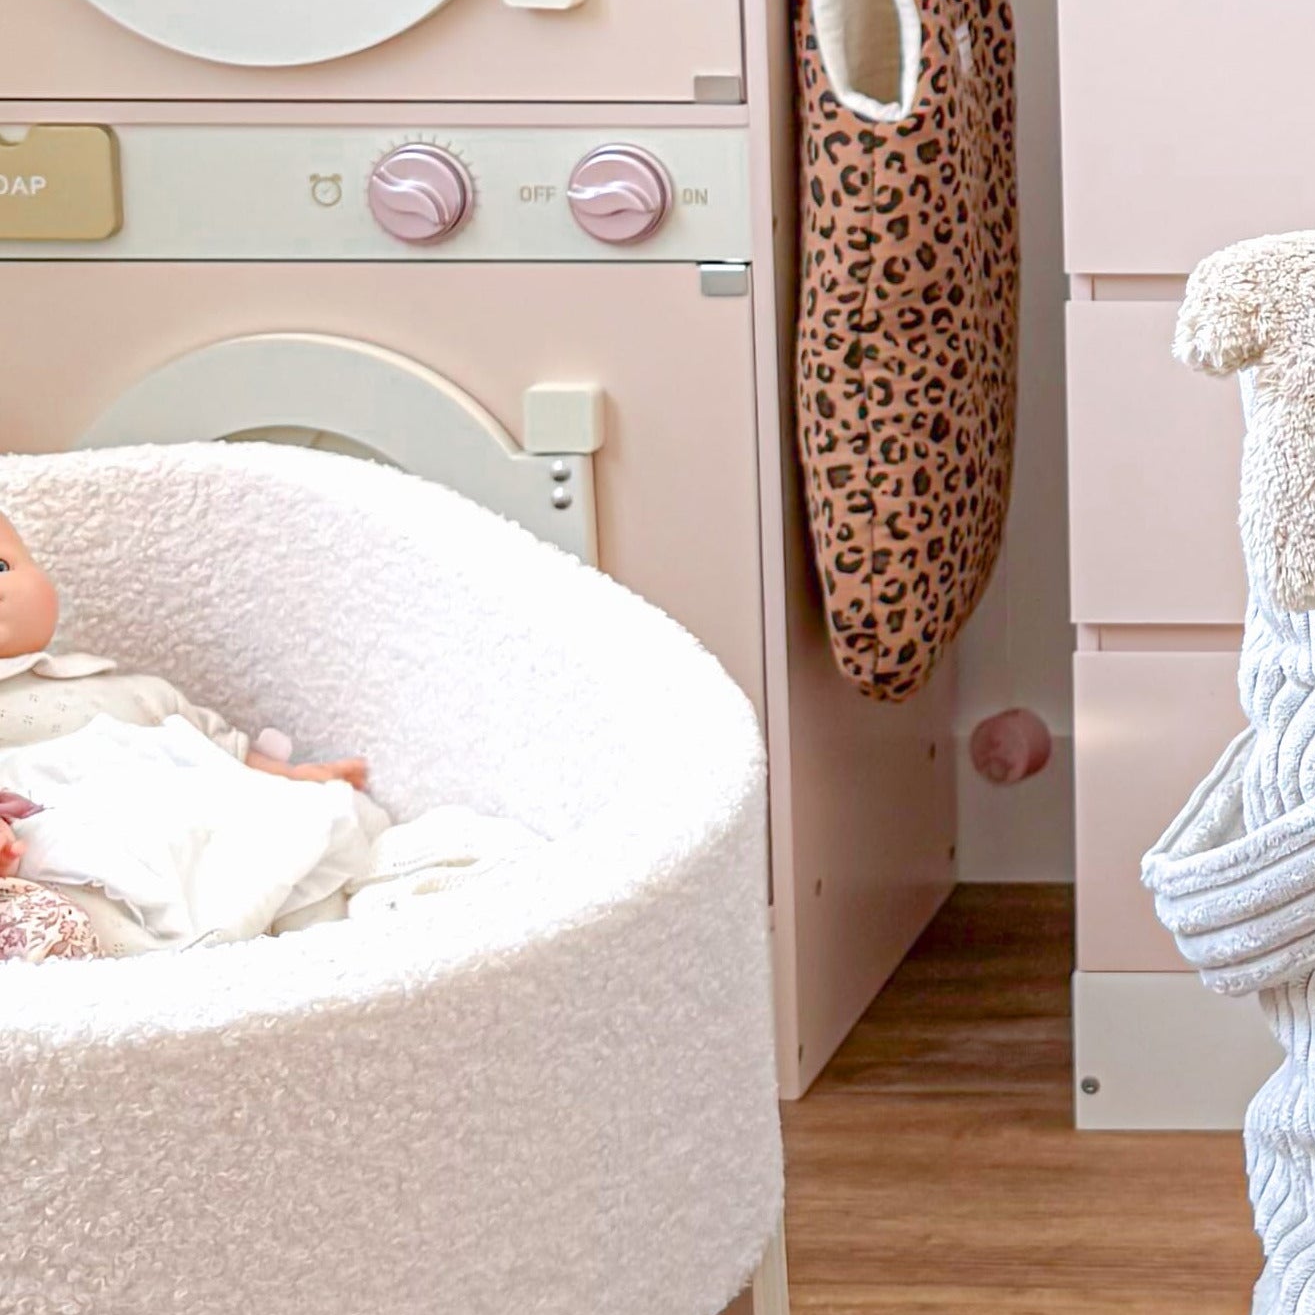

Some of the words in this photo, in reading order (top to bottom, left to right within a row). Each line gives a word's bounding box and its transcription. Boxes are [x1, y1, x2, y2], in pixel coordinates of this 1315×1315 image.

[0, 174, 46, 195] OAP
[519, 186, 557, 202] OFF
[681, 188, 709, 205] ON
